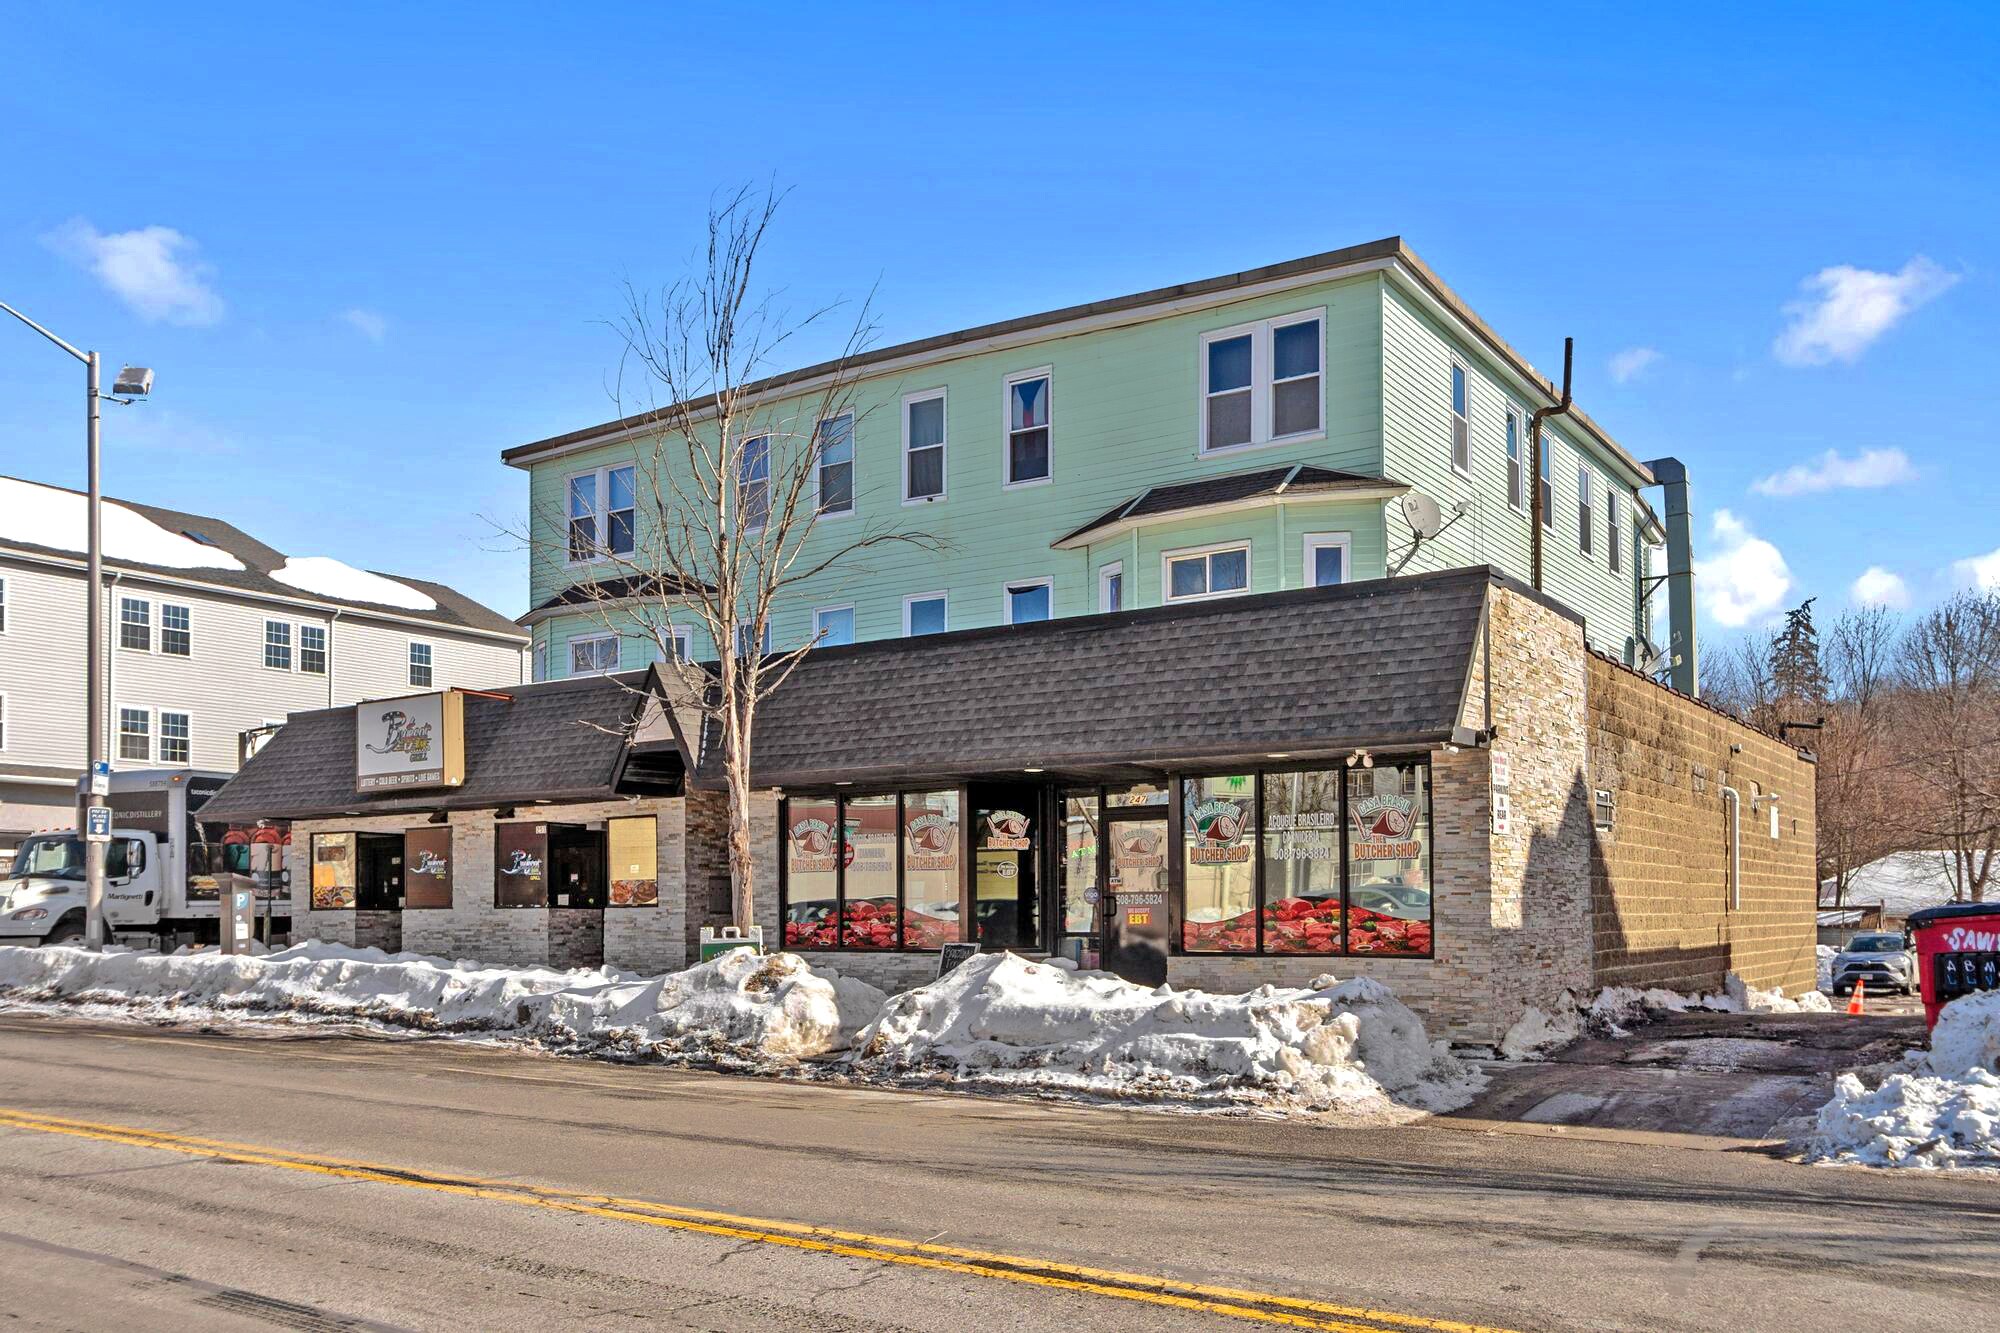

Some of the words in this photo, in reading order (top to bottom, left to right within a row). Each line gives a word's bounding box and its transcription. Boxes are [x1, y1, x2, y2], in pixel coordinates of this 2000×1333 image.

[1129, 795, 1147, 804] 247
[1357, 795, 1380, 817] CASA
[1380, 794, 1411, 814] BRASIL
[1193, 802, 1214, 821] CASA
[1213, 802, 1241, 820] BRASIL
[1297, 812, 1335, 826] BRASILEIRO
[988, 837, 1013, 848] BUTCHER
[1014, 837, 1030, 849] SHOP
[1354, 842, 1393, 859] BUTCHER
[1395, 841, 1420, 859] SHOP
[1190, 846, 1225, 863] BUTCHER
[1226, 845, 1249, 862] SHOP
[906, 855, 937, 869] BUTCHER
[937, 855, 956, 869] SHOP
[107, 893, 143, 901] Martignetti
[1116, 894, 1163, 905] 508-796-5824
[1129, 913, 1149, 925] EBT
[1948, 927, 2000, 952] SAW
